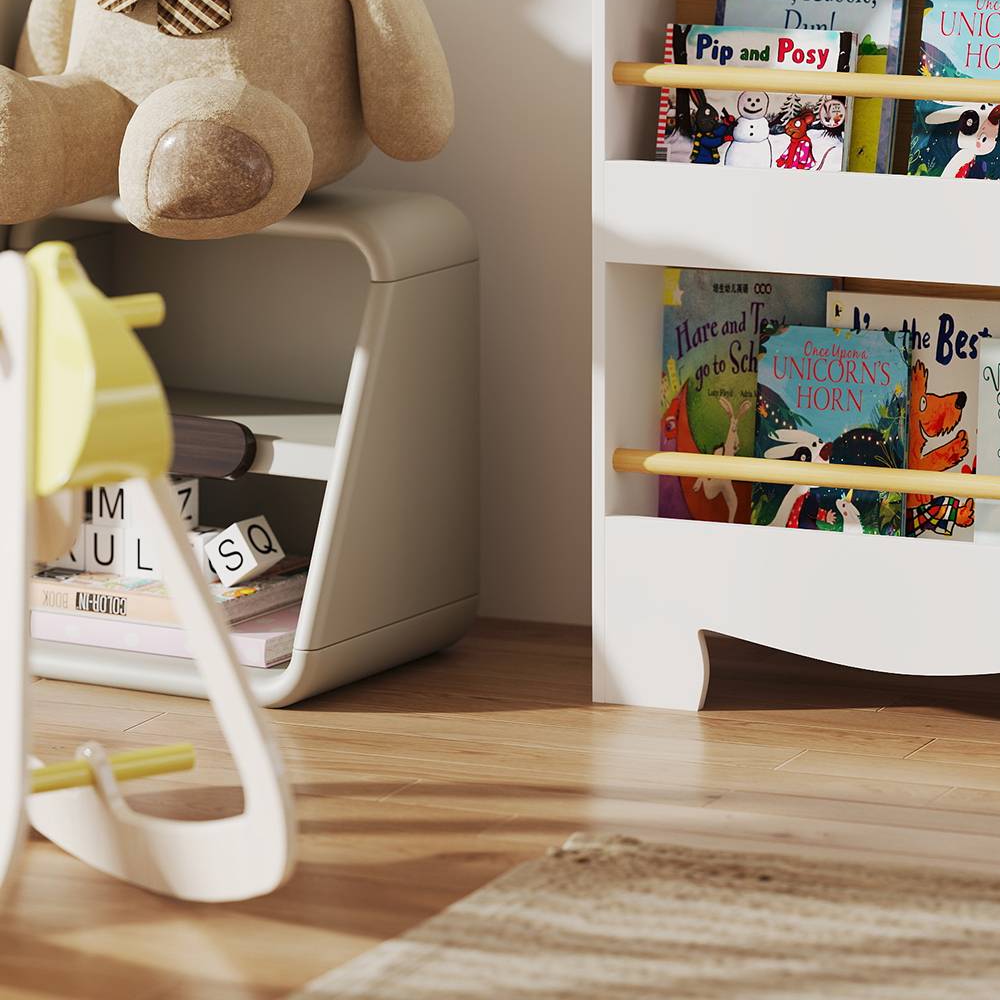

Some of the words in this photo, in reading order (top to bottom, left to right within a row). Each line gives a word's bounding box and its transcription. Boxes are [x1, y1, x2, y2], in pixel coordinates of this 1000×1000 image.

[696, 34, 734, 66] Pip
[739, 44, 770, 62] and
[777, 37, 830, 70] Posy
[675, 319, 718, 360] Hare
[721, 311, 746, 336] and
[695, 364, 710, 392] go
[713, 355, 726, 375] to
[729, 340, 758, 374] Sch
[804, 340, 829, 356] Once
[832, 343, 860, 365] Upon
[861, 352, 868, 360] a
[773, 355, 891, 386] UNICORN'S
[796, 384, 863, 412] HORN
[99, 486, 125, 520] M
[93, 532, 114, 566] U
[136, 538, 153, 571] L
[218, 539, 244, 572] S
[247, 524, 277, 554] Q
